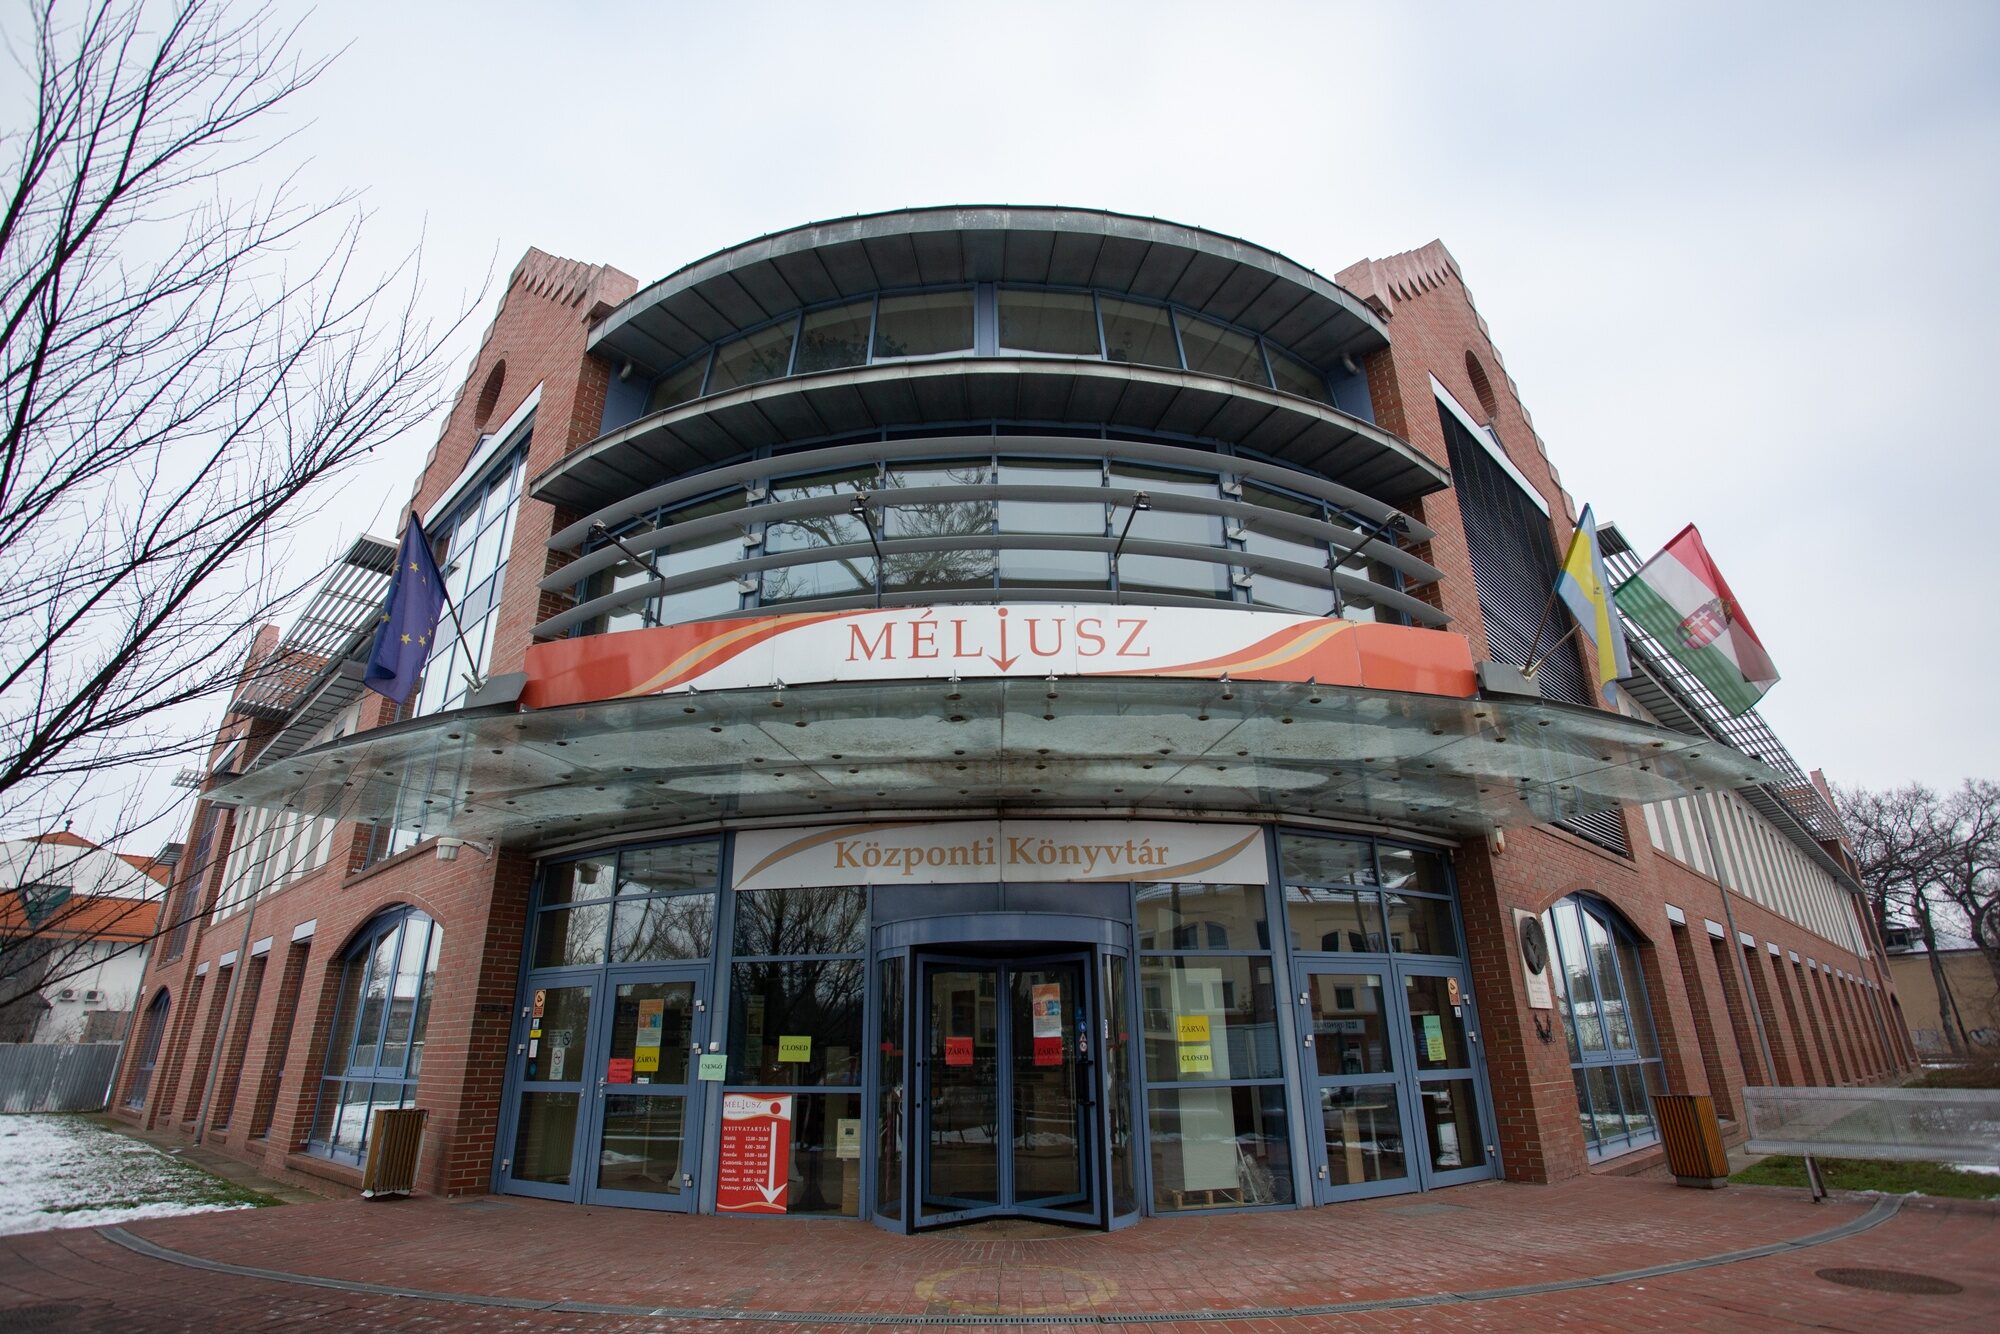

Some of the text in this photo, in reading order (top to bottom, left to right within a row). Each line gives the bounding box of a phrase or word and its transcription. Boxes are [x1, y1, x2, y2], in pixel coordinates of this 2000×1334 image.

[834, 836, 1170, 876] Központi Könyvtár
[1180, 1024, 1206, 1033] ZÁRVA
[947, 1046, 970, 1056] ZÁRVA
[636, 1054, 657, 1063] ZÁRVA
[1181, 1054, 1209, 1062] CLOSED
